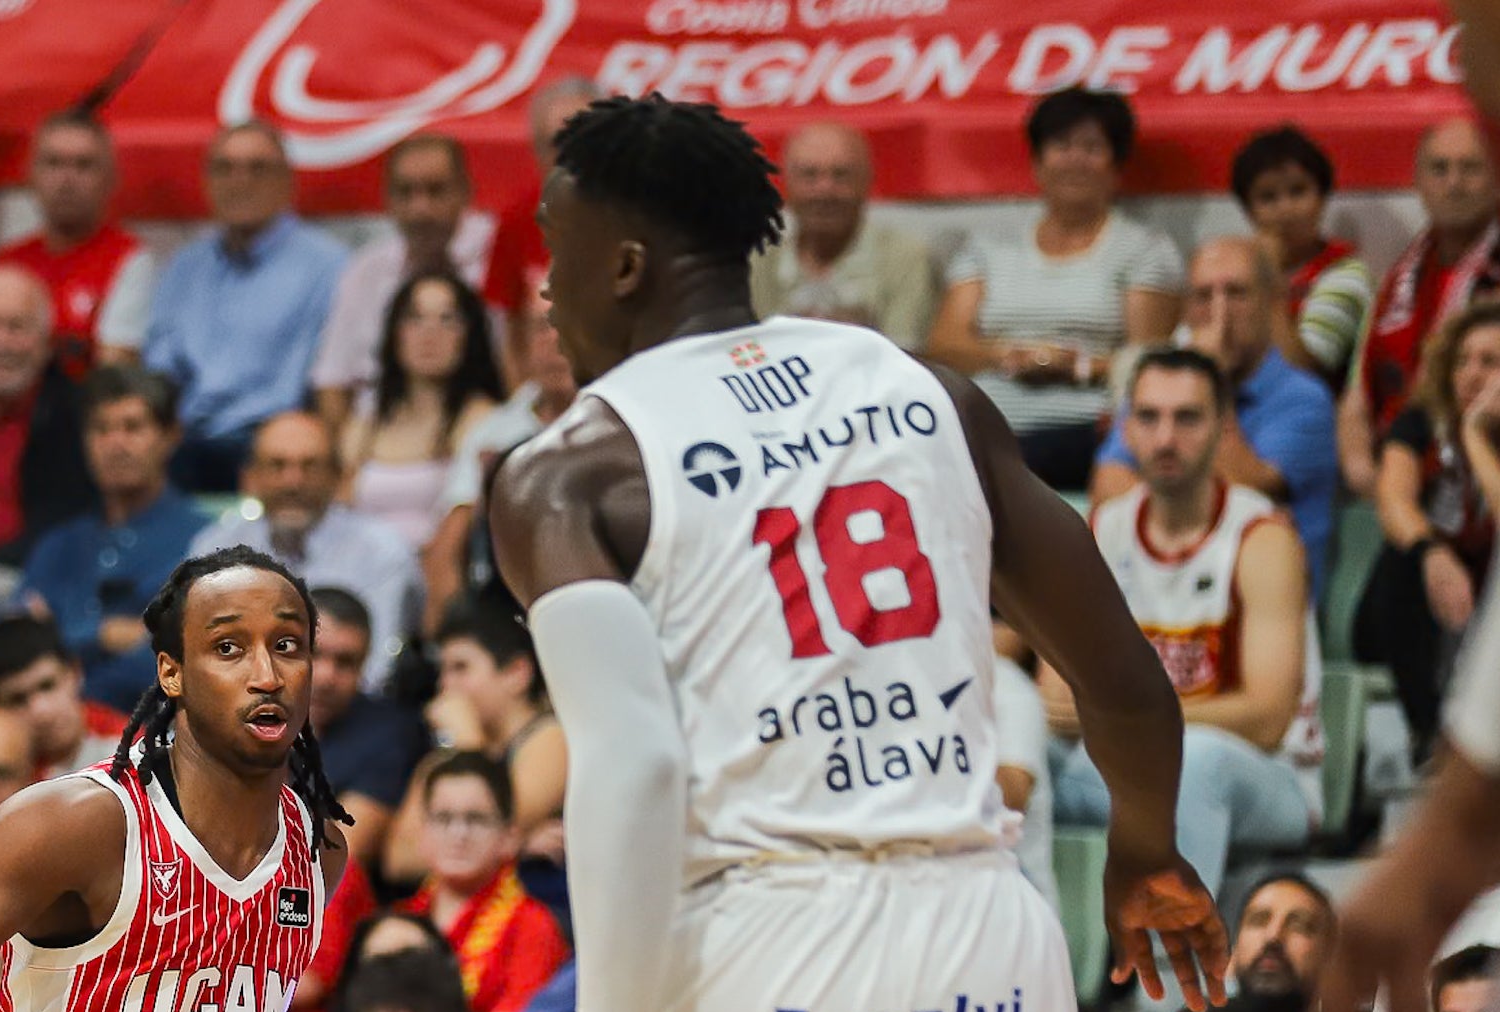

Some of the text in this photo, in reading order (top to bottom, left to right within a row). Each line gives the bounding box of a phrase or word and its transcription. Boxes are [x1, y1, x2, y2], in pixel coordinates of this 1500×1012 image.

[1008, 24, 1171, 96] DE
[720, 355, 813, 413] DIOP
[759, 401, 937, 477] AMUTIO
[752, 480, 942, 659] 18
[758, 677, 918, 744] araba
[826, 734, 971, 792] álava
